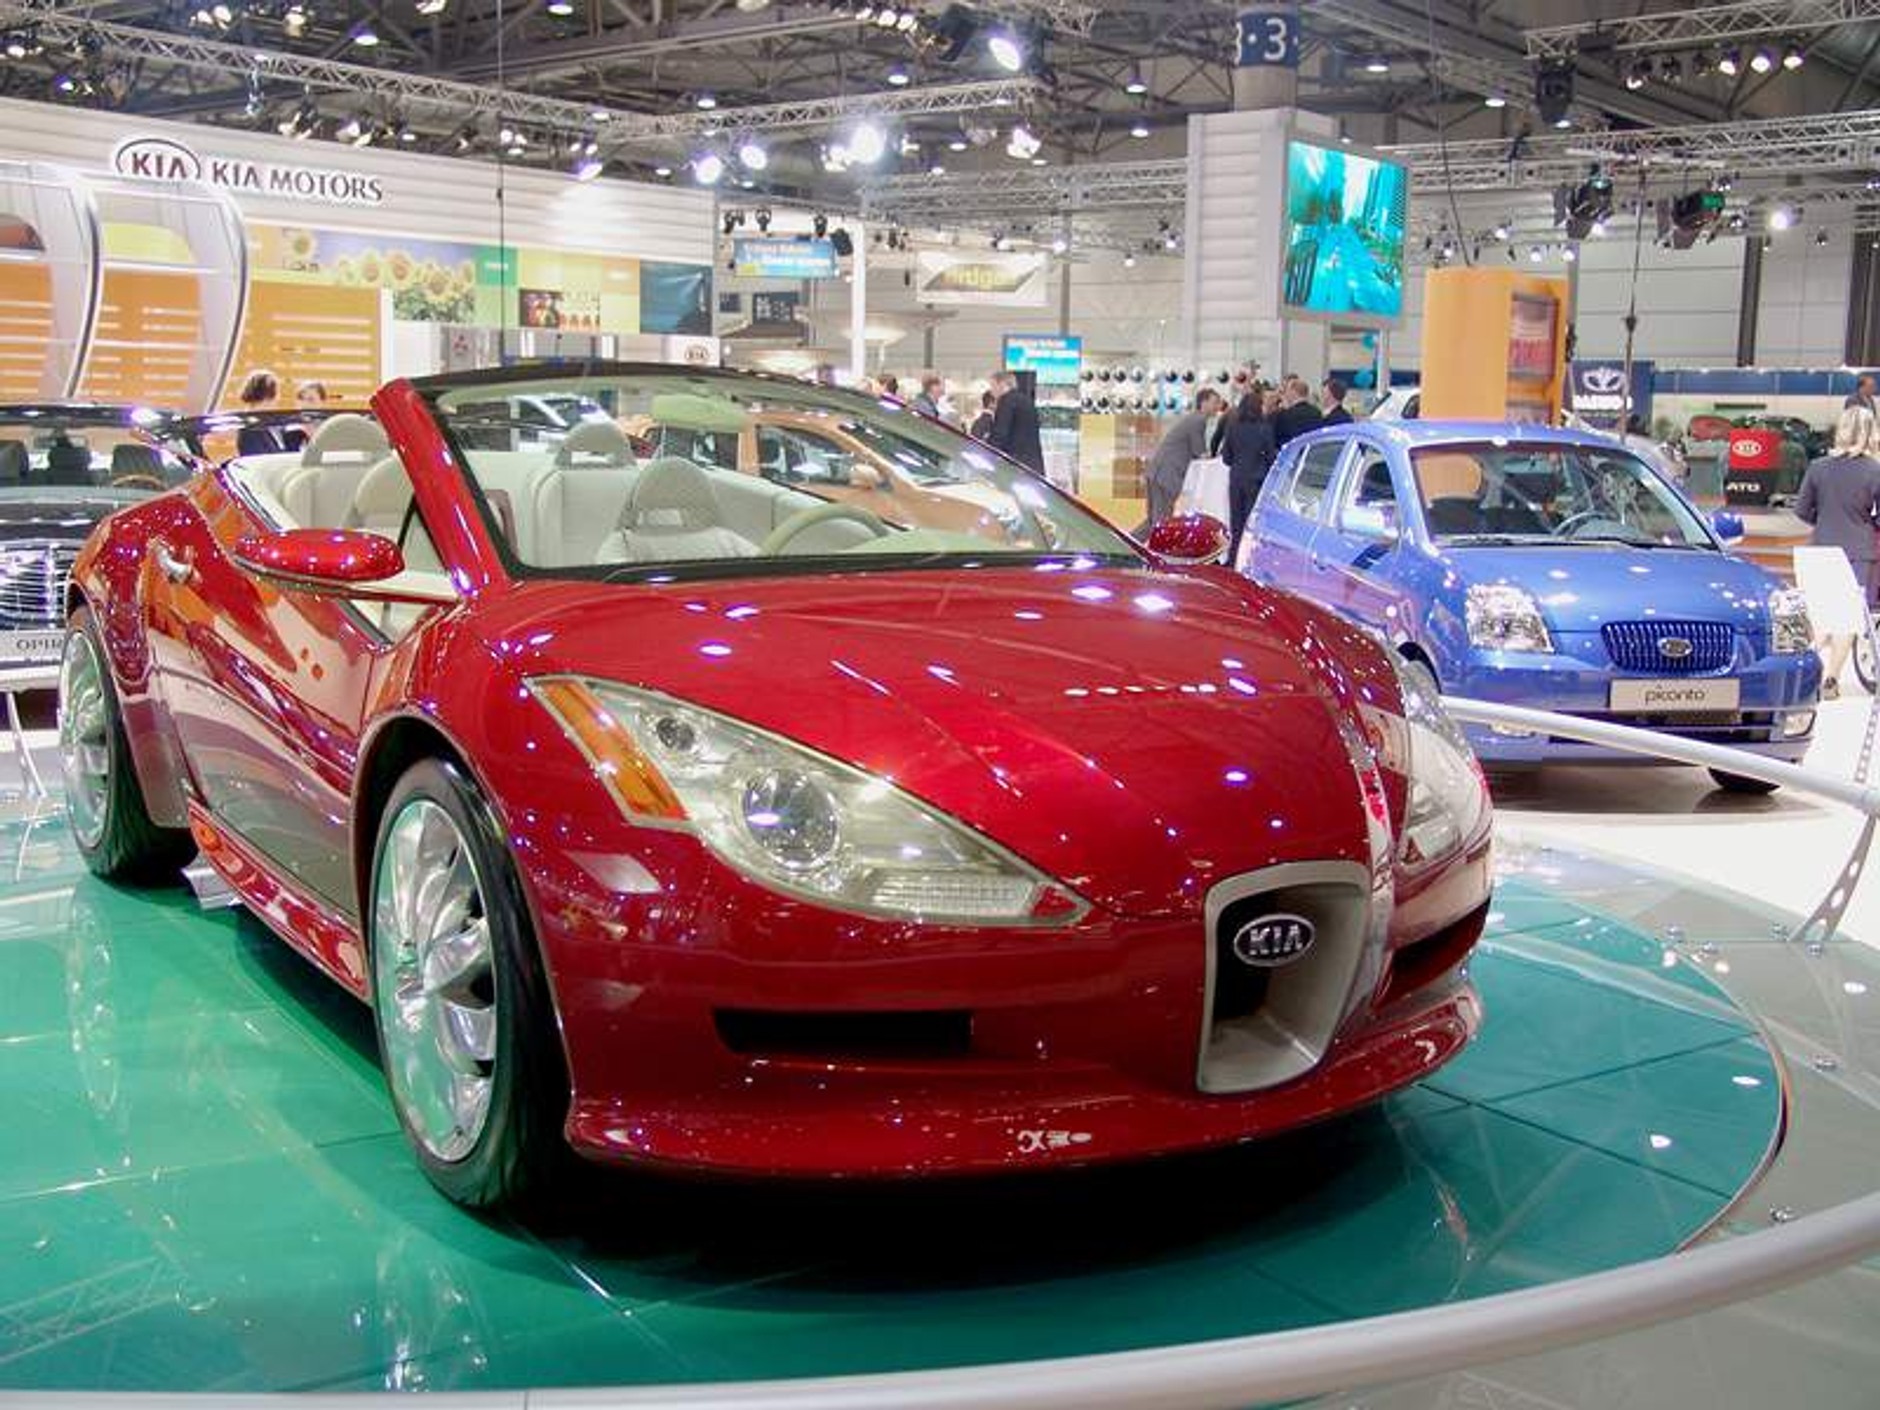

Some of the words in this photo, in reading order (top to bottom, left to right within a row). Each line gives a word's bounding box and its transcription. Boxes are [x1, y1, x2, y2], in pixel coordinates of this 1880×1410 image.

[131, 151, 188, 180] KIA
[212, 161, 262, 189] KIA
[269, 168, 383, 201] MOTORS
[1249, 923, 1303, 956] KIA
